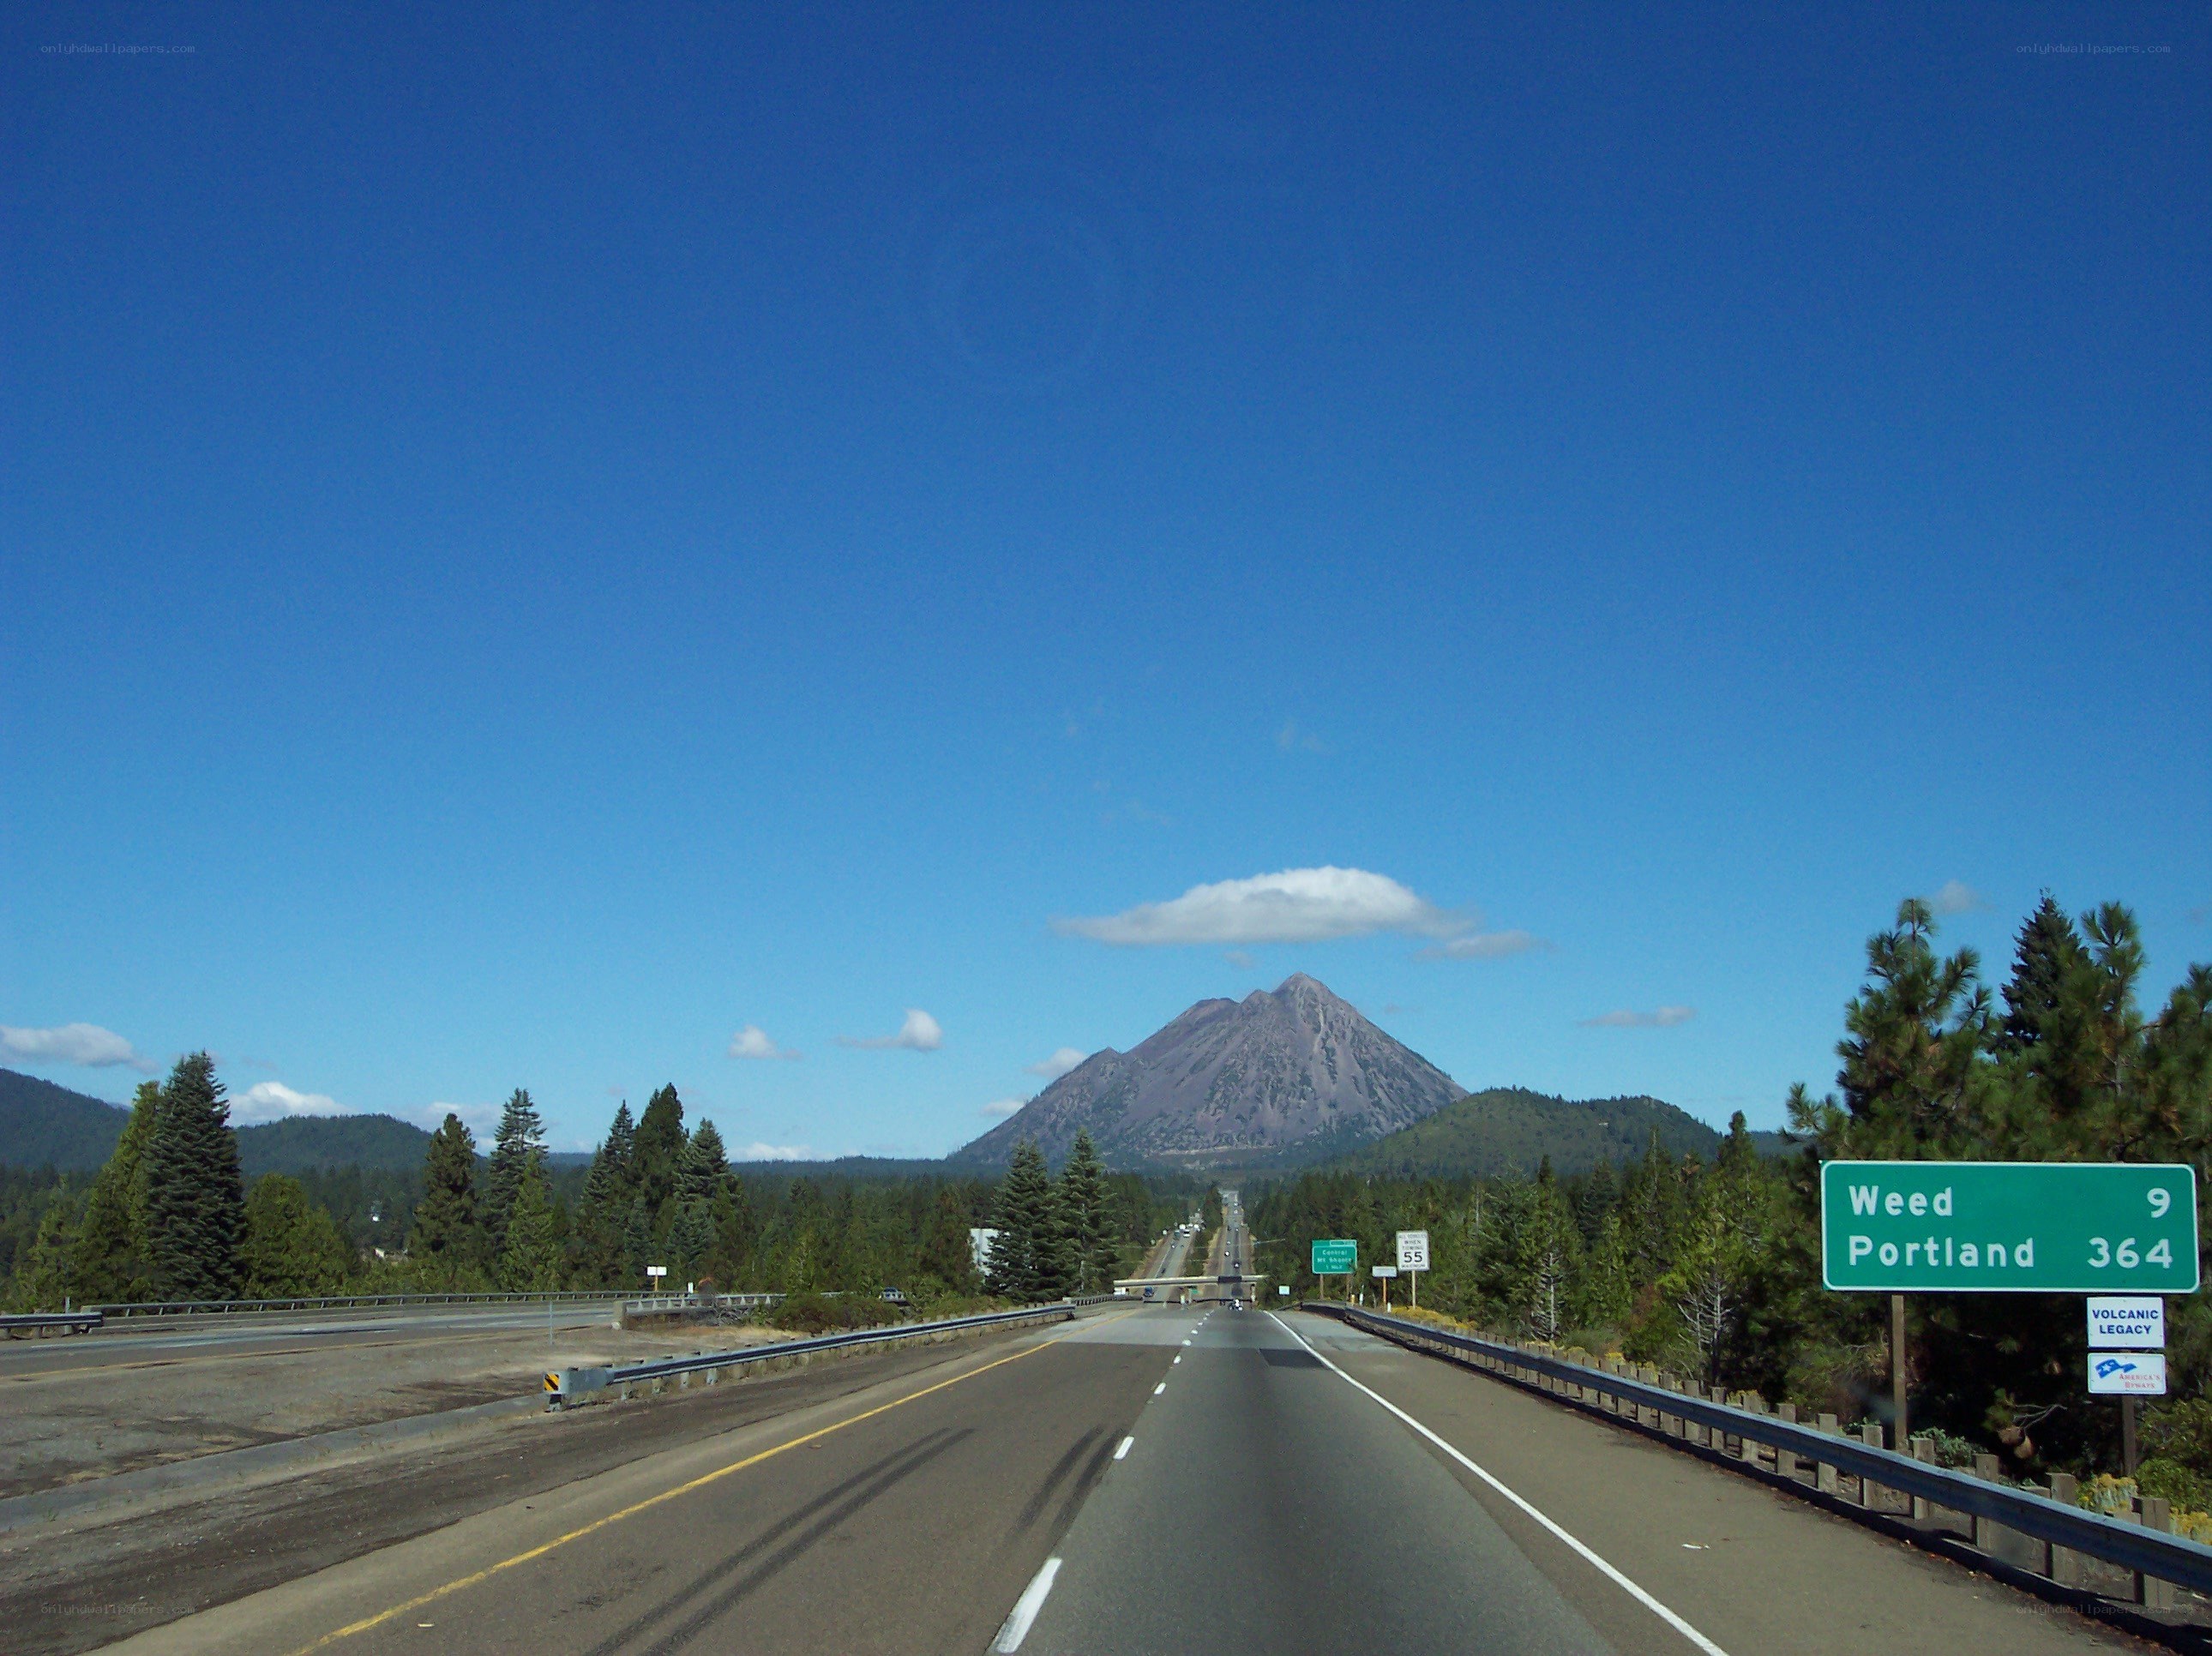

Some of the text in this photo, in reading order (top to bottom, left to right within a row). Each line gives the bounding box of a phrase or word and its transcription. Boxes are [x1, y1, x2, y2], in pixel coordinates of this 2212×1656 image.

[1848, 1185, 2170, 1218] Weed 9
[1404, 1251, 1423, 1263] 55
[1848, 1235, 2173, 1269] Portland 364
[2092, 1309, 2159, 1319] VOLCANIC
[2099, 1324, 2152, 1335] LEGACY
